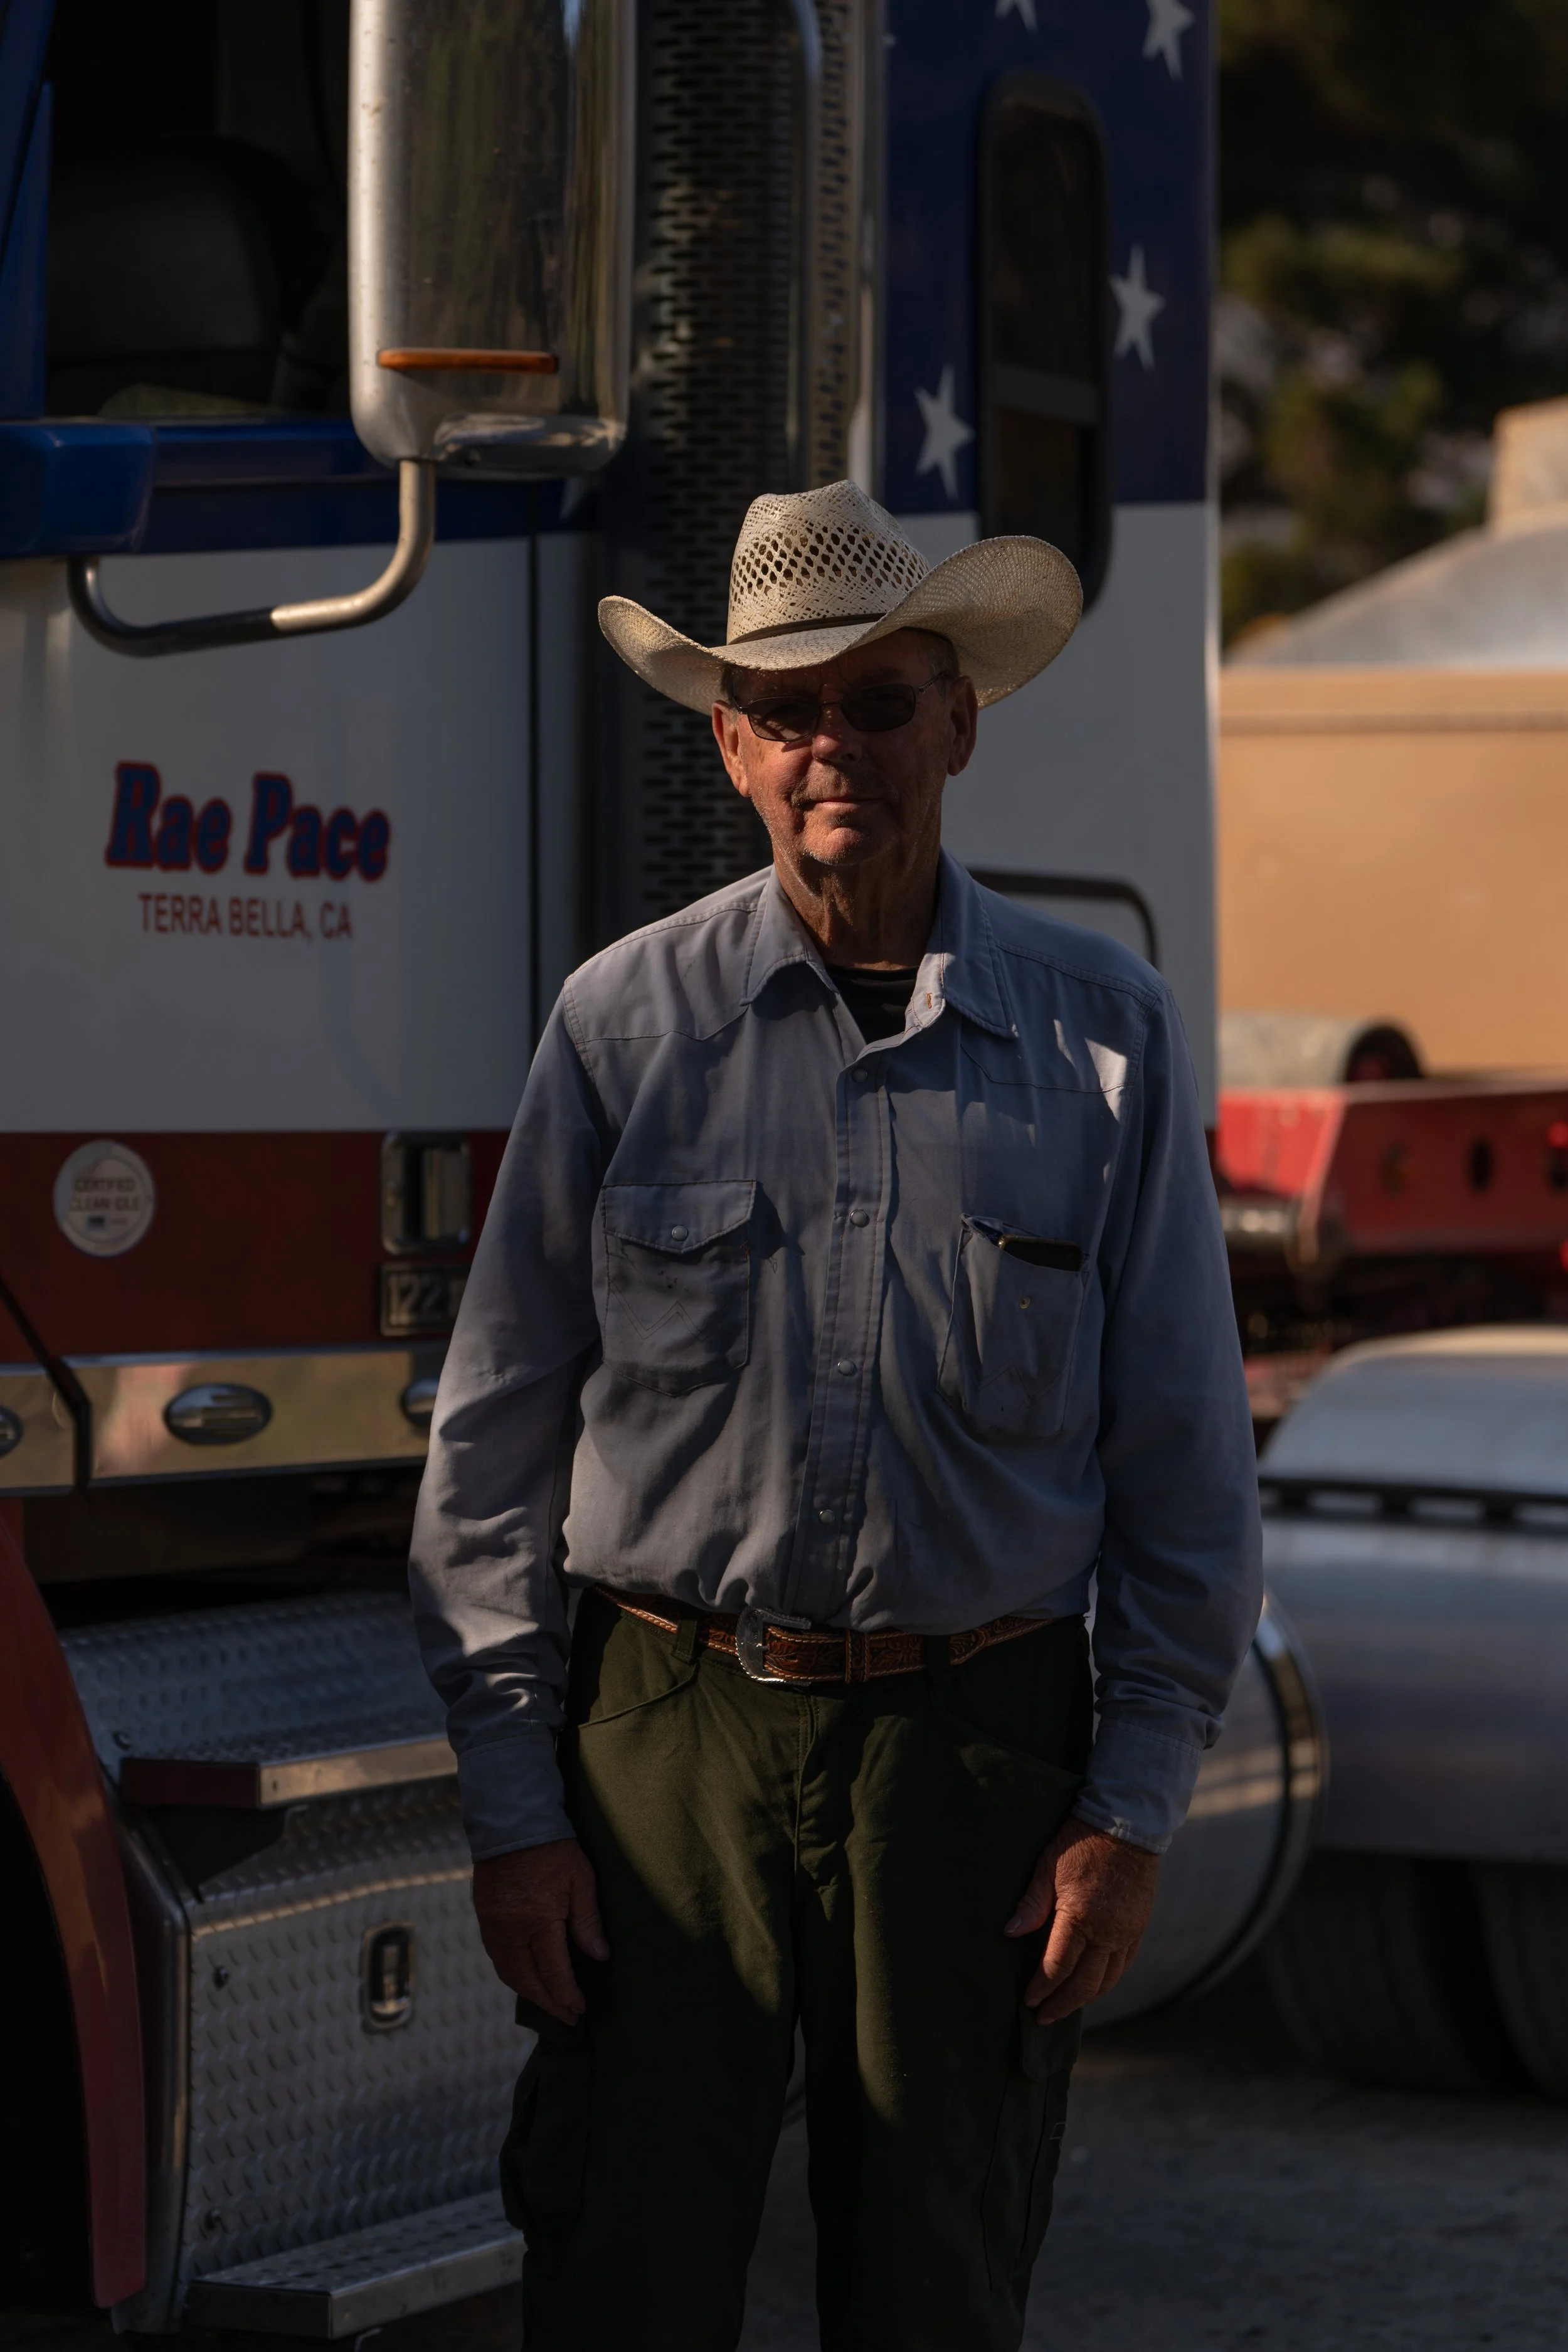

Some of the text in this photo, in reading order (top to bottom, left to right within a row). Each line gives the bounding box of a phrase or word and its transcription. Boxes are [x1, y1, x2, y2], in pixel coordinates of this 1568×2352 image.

[105, 760, 390, 884] Rae Pace
[138, 893, 353, 943] TERRA BELLA, CA
